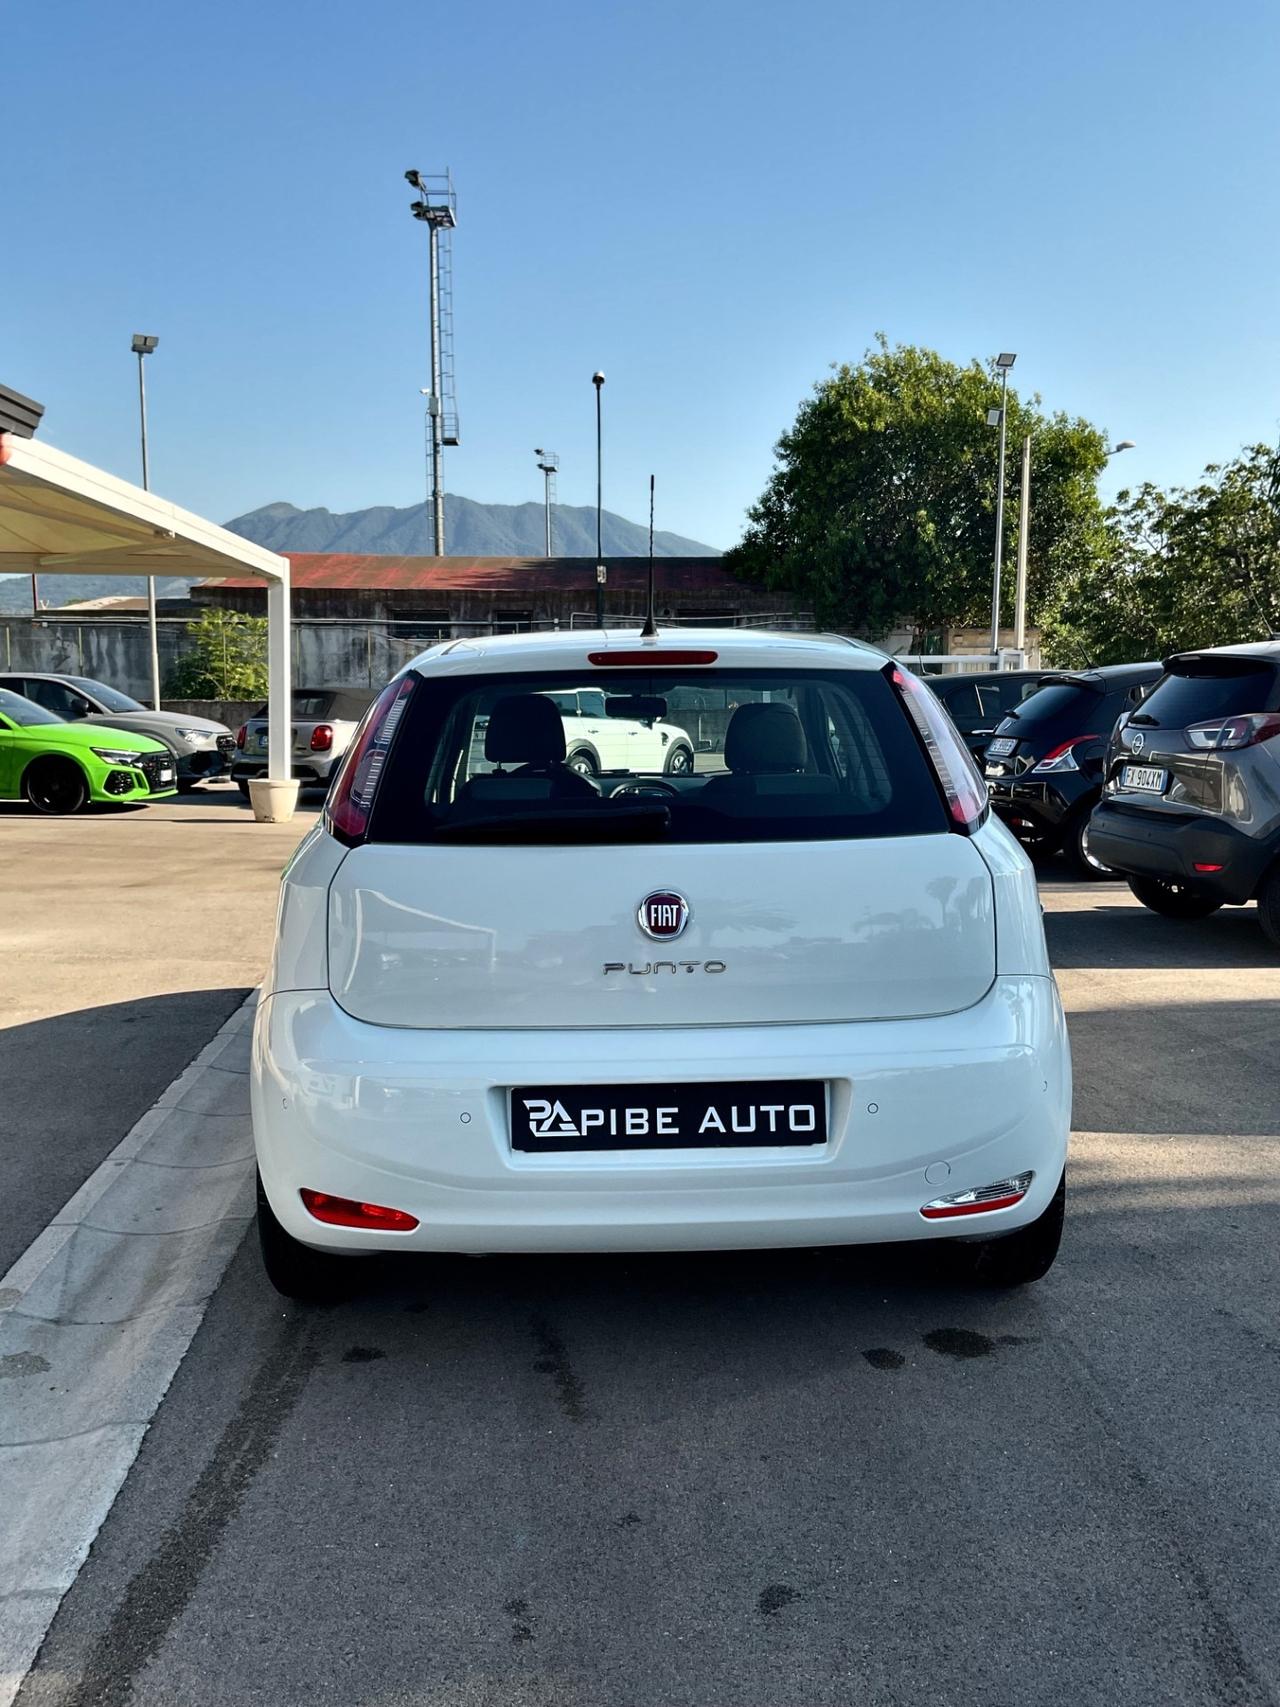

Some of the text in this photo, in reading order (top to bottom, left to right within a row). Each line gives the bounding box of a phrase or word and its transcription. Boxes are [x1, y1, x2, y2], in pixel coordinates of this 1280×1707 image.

[650, 904, 679, 927] FIAT
[580, 1106, 680, 1137] PIBE
[698, 1104, 816, 1134] AUTO
